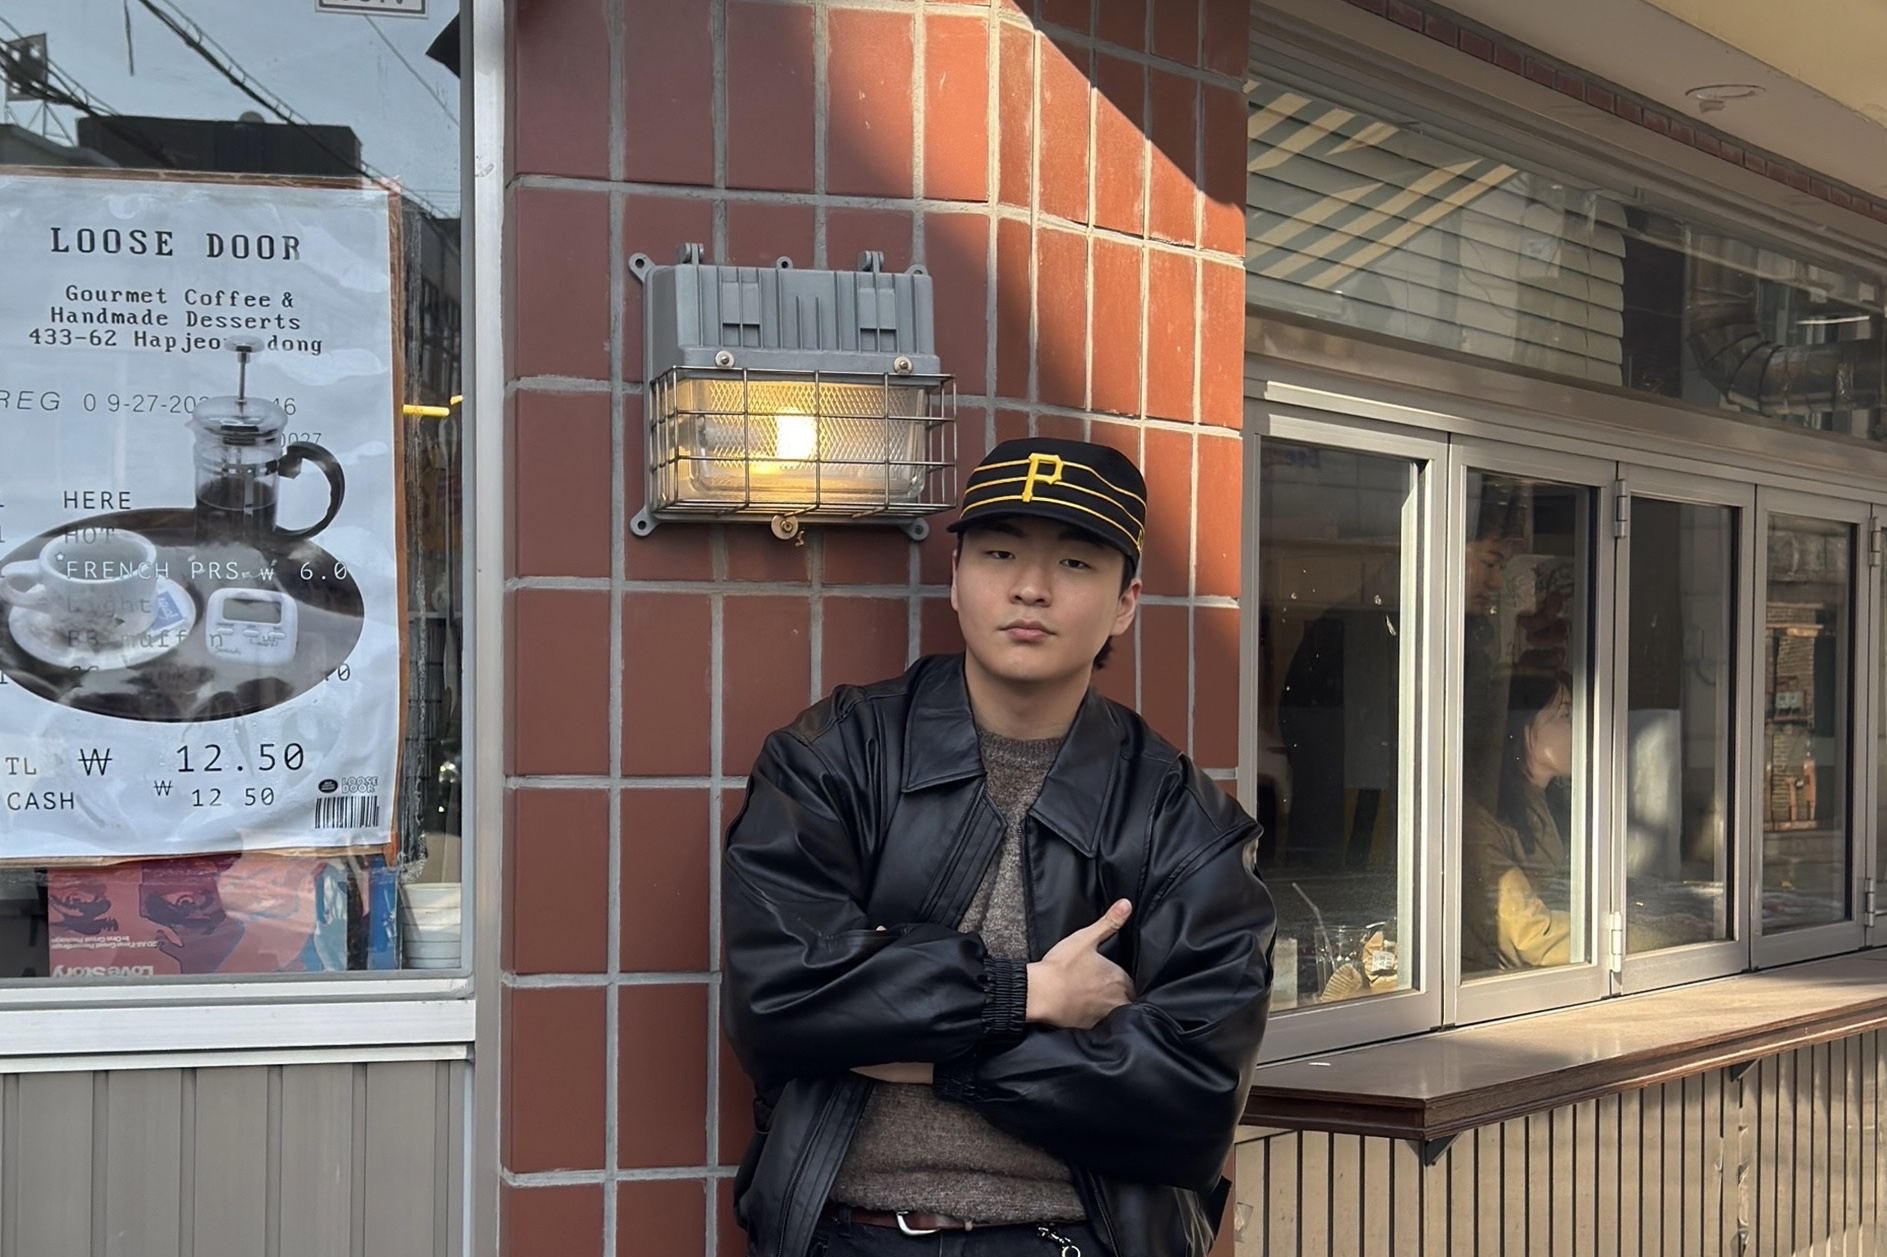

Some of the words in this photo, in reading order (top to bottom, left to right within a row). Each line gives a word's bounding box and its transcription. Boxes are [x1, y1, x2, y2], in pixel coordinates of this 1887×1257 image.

[51, 227, 173, 256] LOOSE
[206, 233, 300, 260] DOOR
[66, 284, 167, 304] Gourmet
[184, 288, 271, 307] Coffee
[281, 291, 293, 308] &
[51, 306, 169, 326] Handmade
[186, 310, 301, 330] Desserts
[29, 328, 117, 346] 433-62
[1022, 453, 1064, 502] P
[63, 490, 131, 509] HERE
[66, 561, 169, 579] FRENCH
[191, 561, 238, 579] PRS
[121, 628, 223, 648] muffn
[177, 743, 304, 772] 12.50
[342, 776, 378, 786] LOOSE
[342, 785, 376, 794] DOOR
[7, 792, 74, 810] CASH
